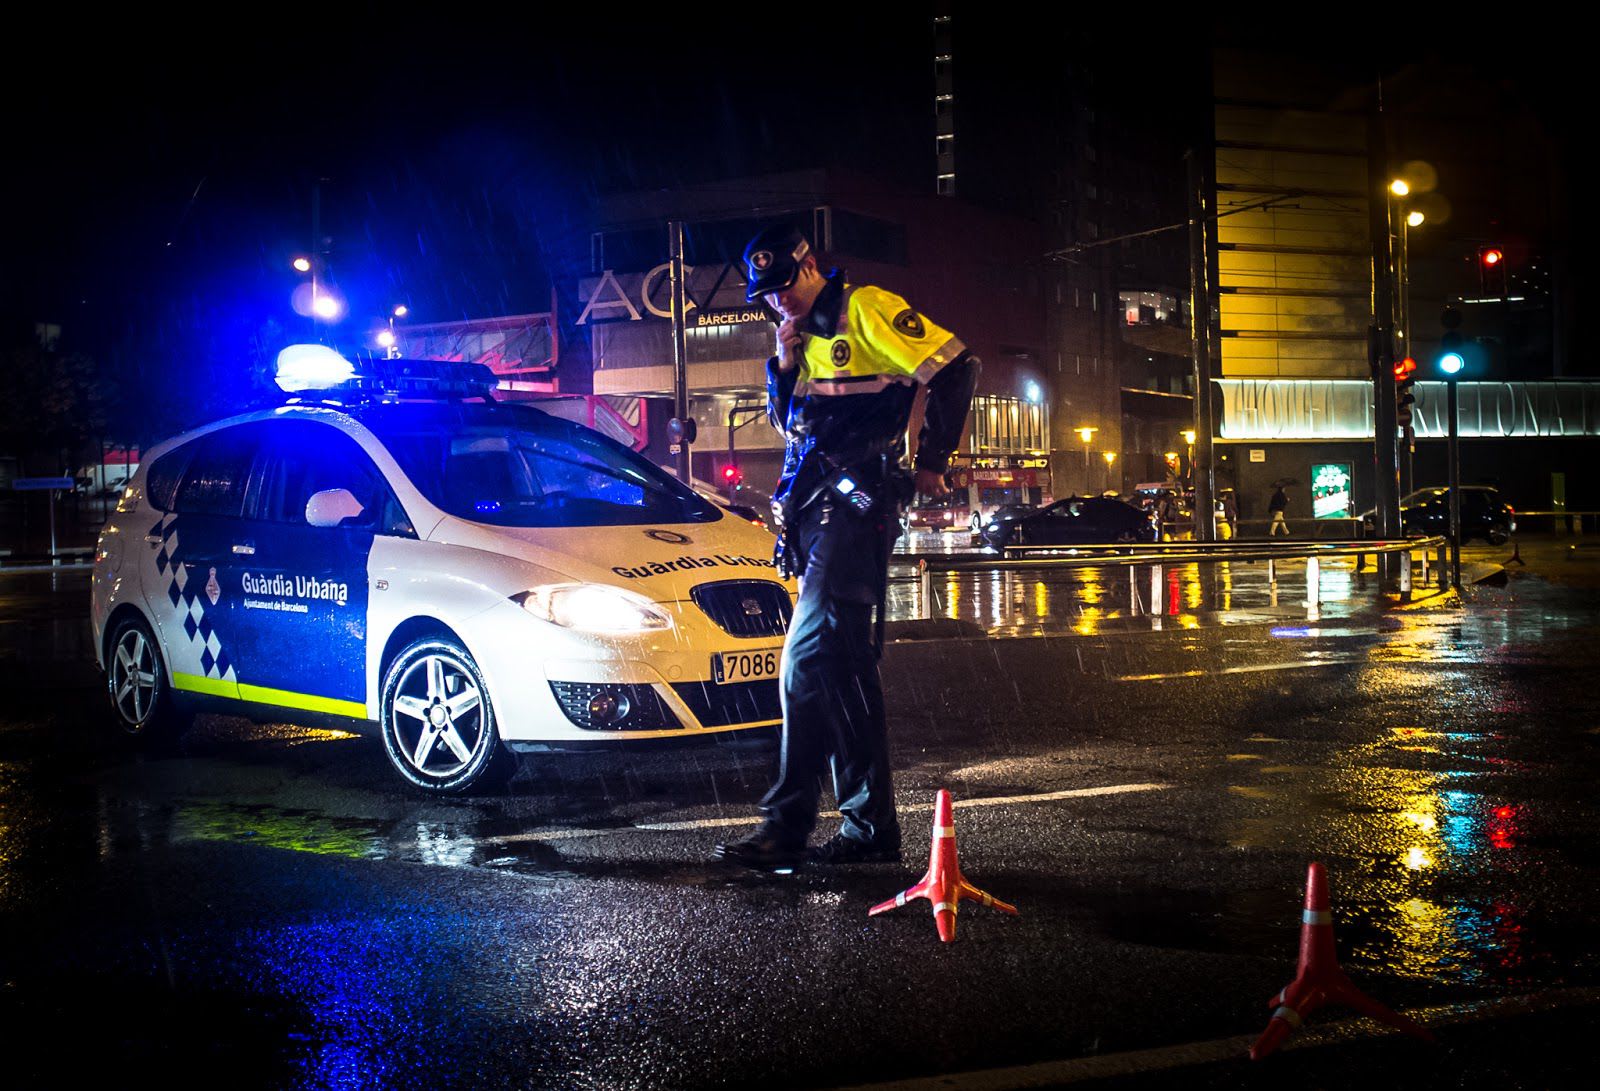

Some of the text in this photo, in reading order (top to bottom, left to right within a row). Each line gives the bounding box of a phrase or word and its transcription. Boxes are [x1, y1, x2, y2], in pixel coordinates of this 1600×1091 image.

[575, 263, 697, 326] AC
[698, 312, 766, 326] BARCELONA
[612, 556, 718, 579] Guàrdia
[242, 572, 348, 601] Guàrdia Urbana
[243, 598, 308, 613] Ajuntament de Barcelona
[718, 652, 776, 679] E 7086
